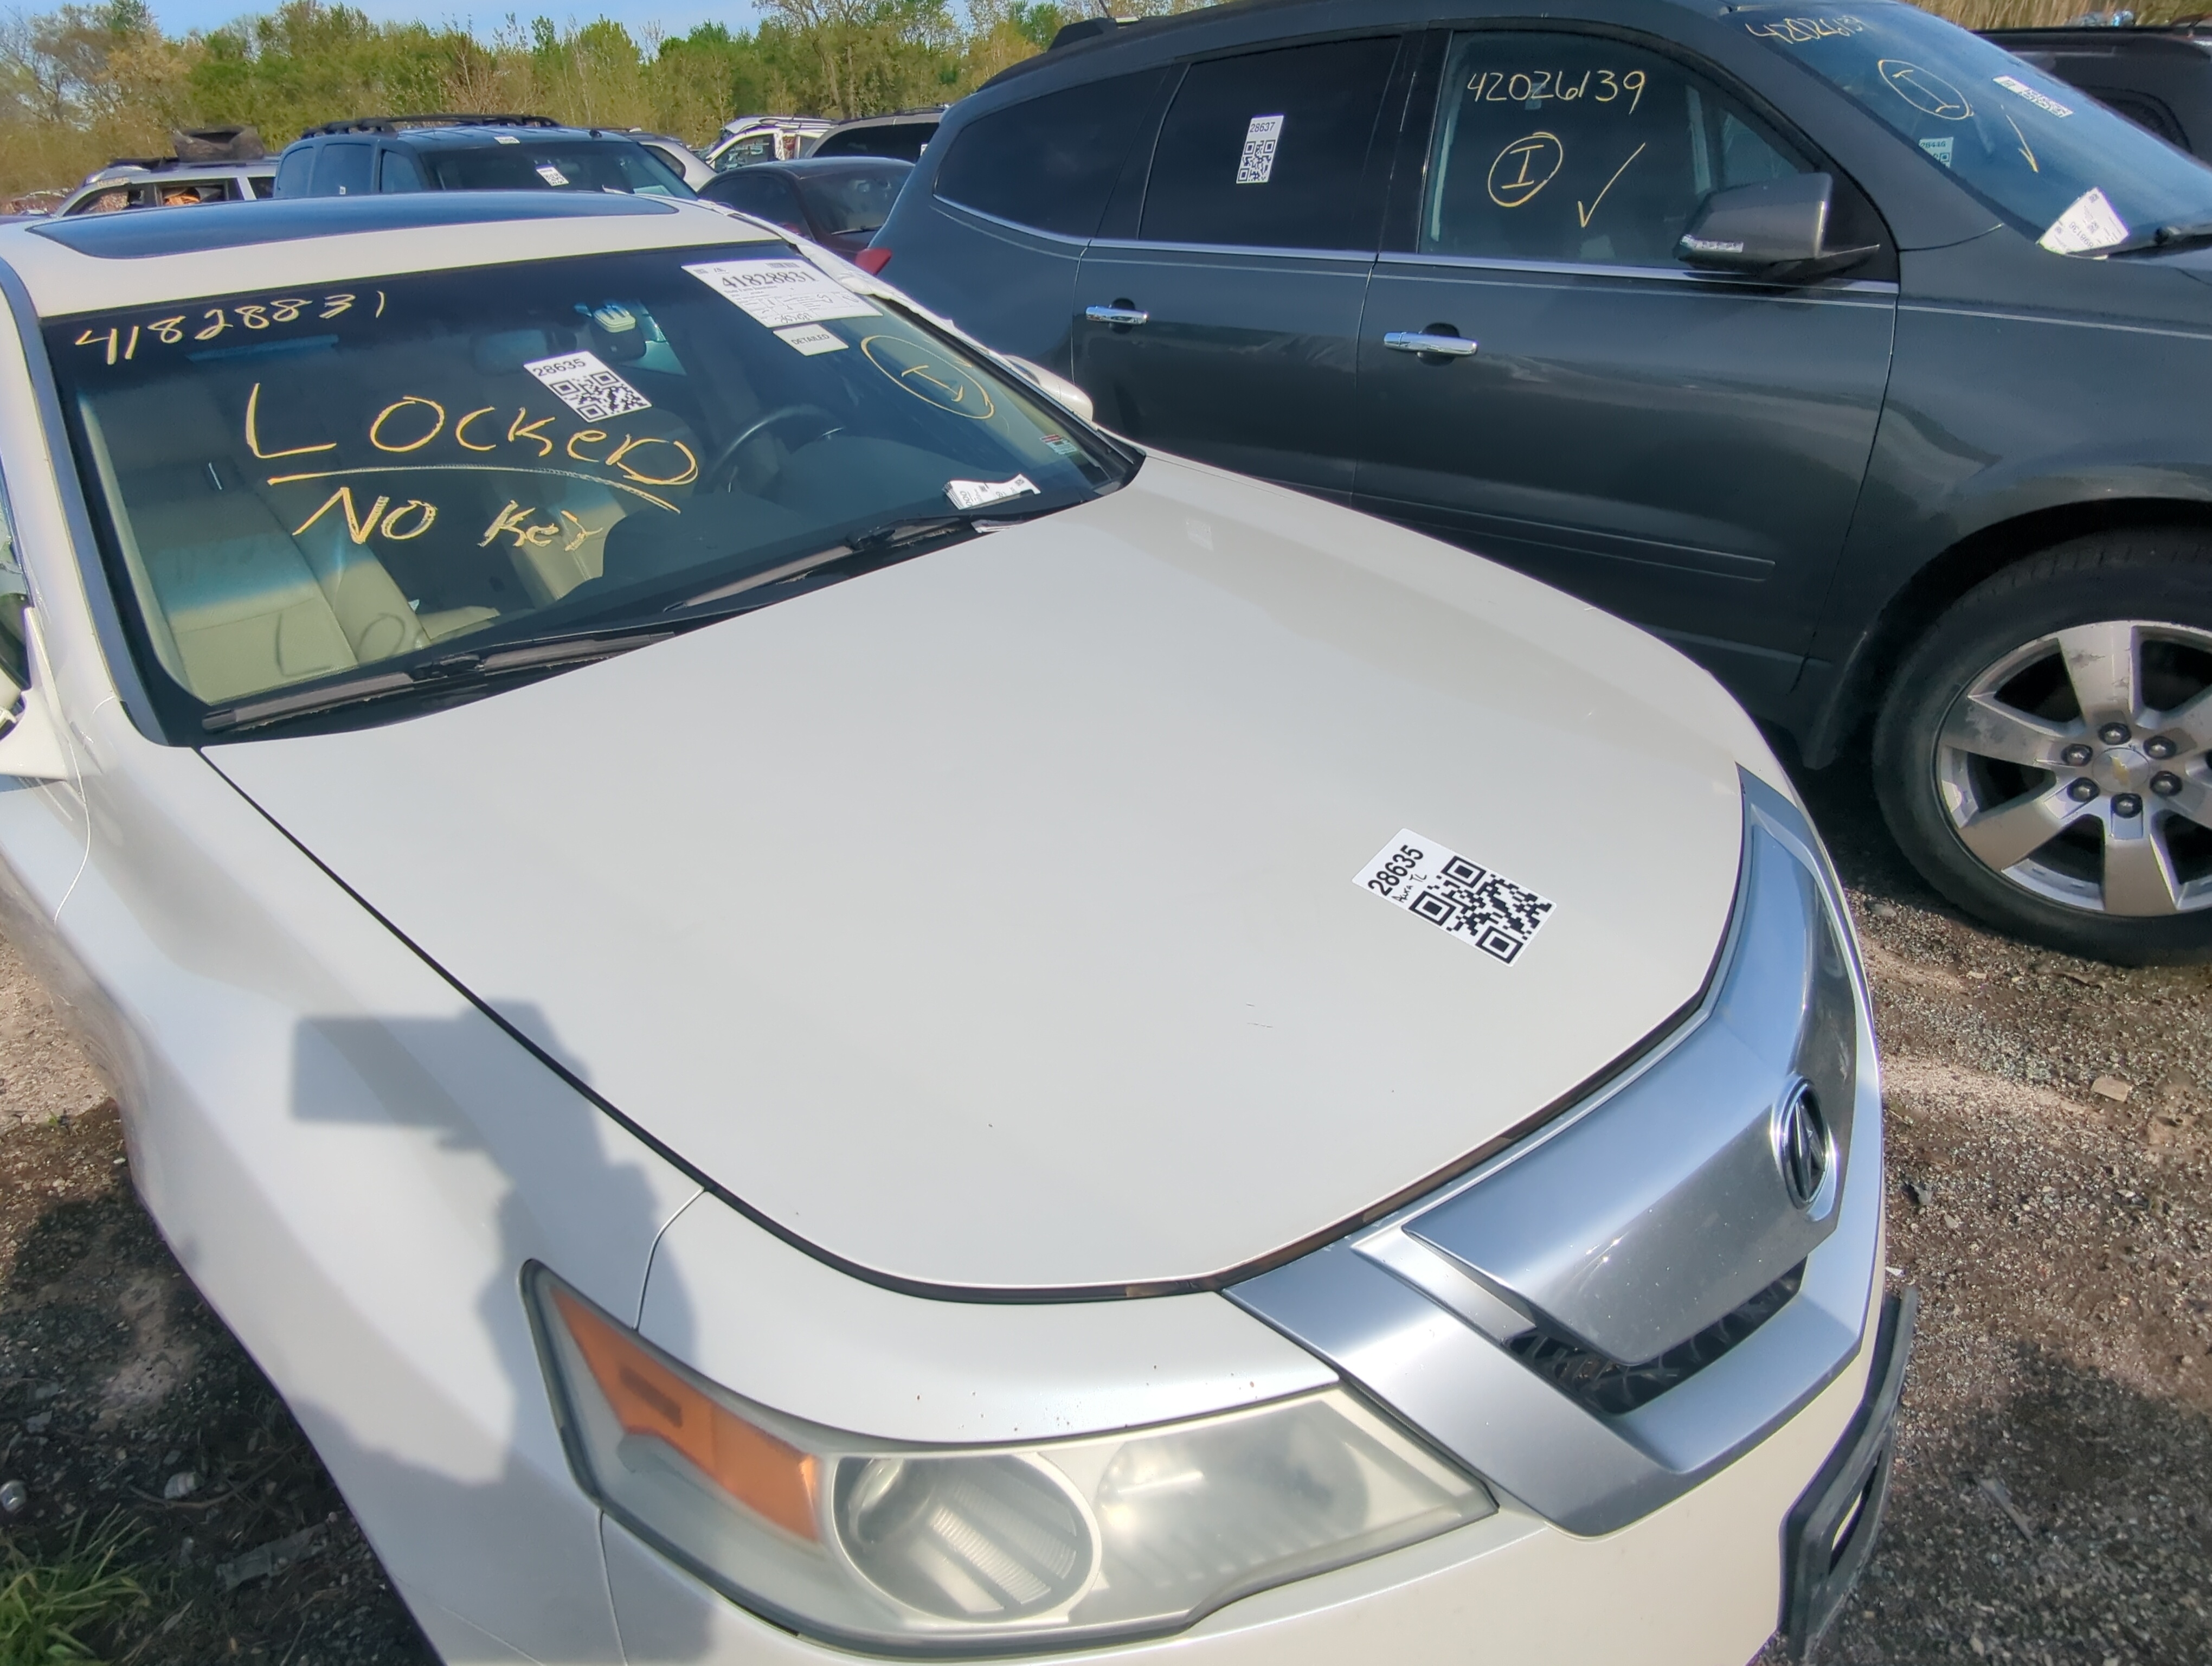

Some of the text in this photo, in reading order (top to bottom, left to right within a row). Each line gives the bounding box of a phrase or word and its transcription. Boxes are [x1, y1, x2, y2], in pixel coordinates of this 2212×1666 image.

[1467, 71, 1647, 114] 42026139
[1249, 121, 1276, 133] 28637
[722, 271, 820, 288] 41828831
[75, 290, 386, 366] 41828831
[791, 334, 829, 346] DETAILED
[532, 358, 587, 377] 28635
[1368, 844, 1424, 896] 28635
